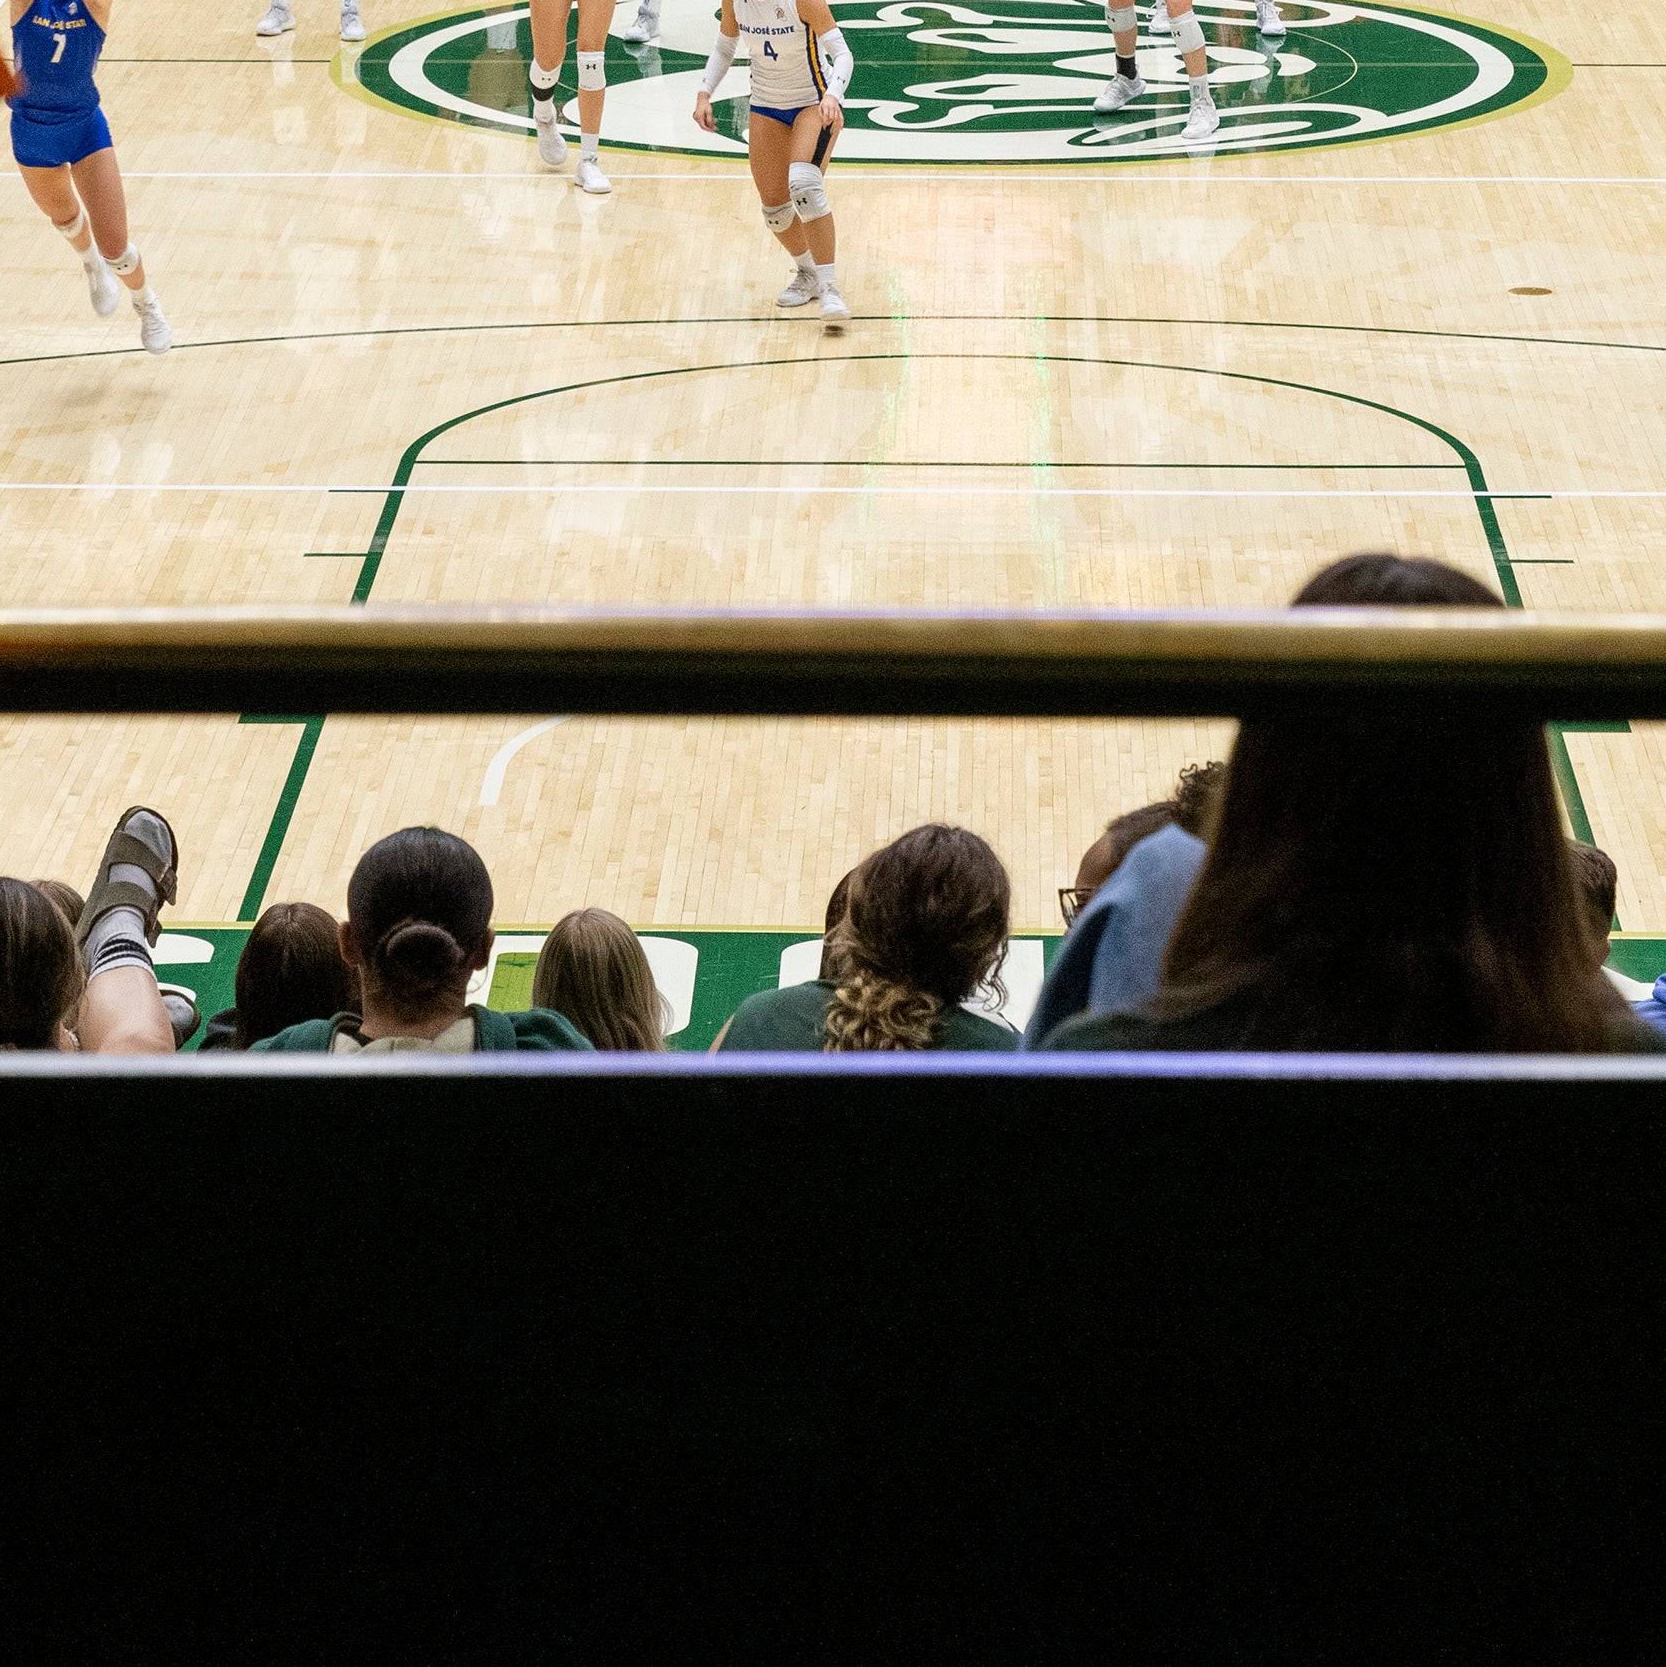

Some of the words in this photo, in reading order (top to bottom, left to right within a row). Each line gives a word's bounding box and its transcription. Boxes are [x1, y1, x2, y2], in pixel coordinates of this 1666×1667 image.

[739, 23, 751, 34] SAN
[751, 23, 771, 35] JOSÉ
[771, 24, 795, 35] STATE
[51, 33, 67, 63] 7
[763, 40, 779, 62] 4
